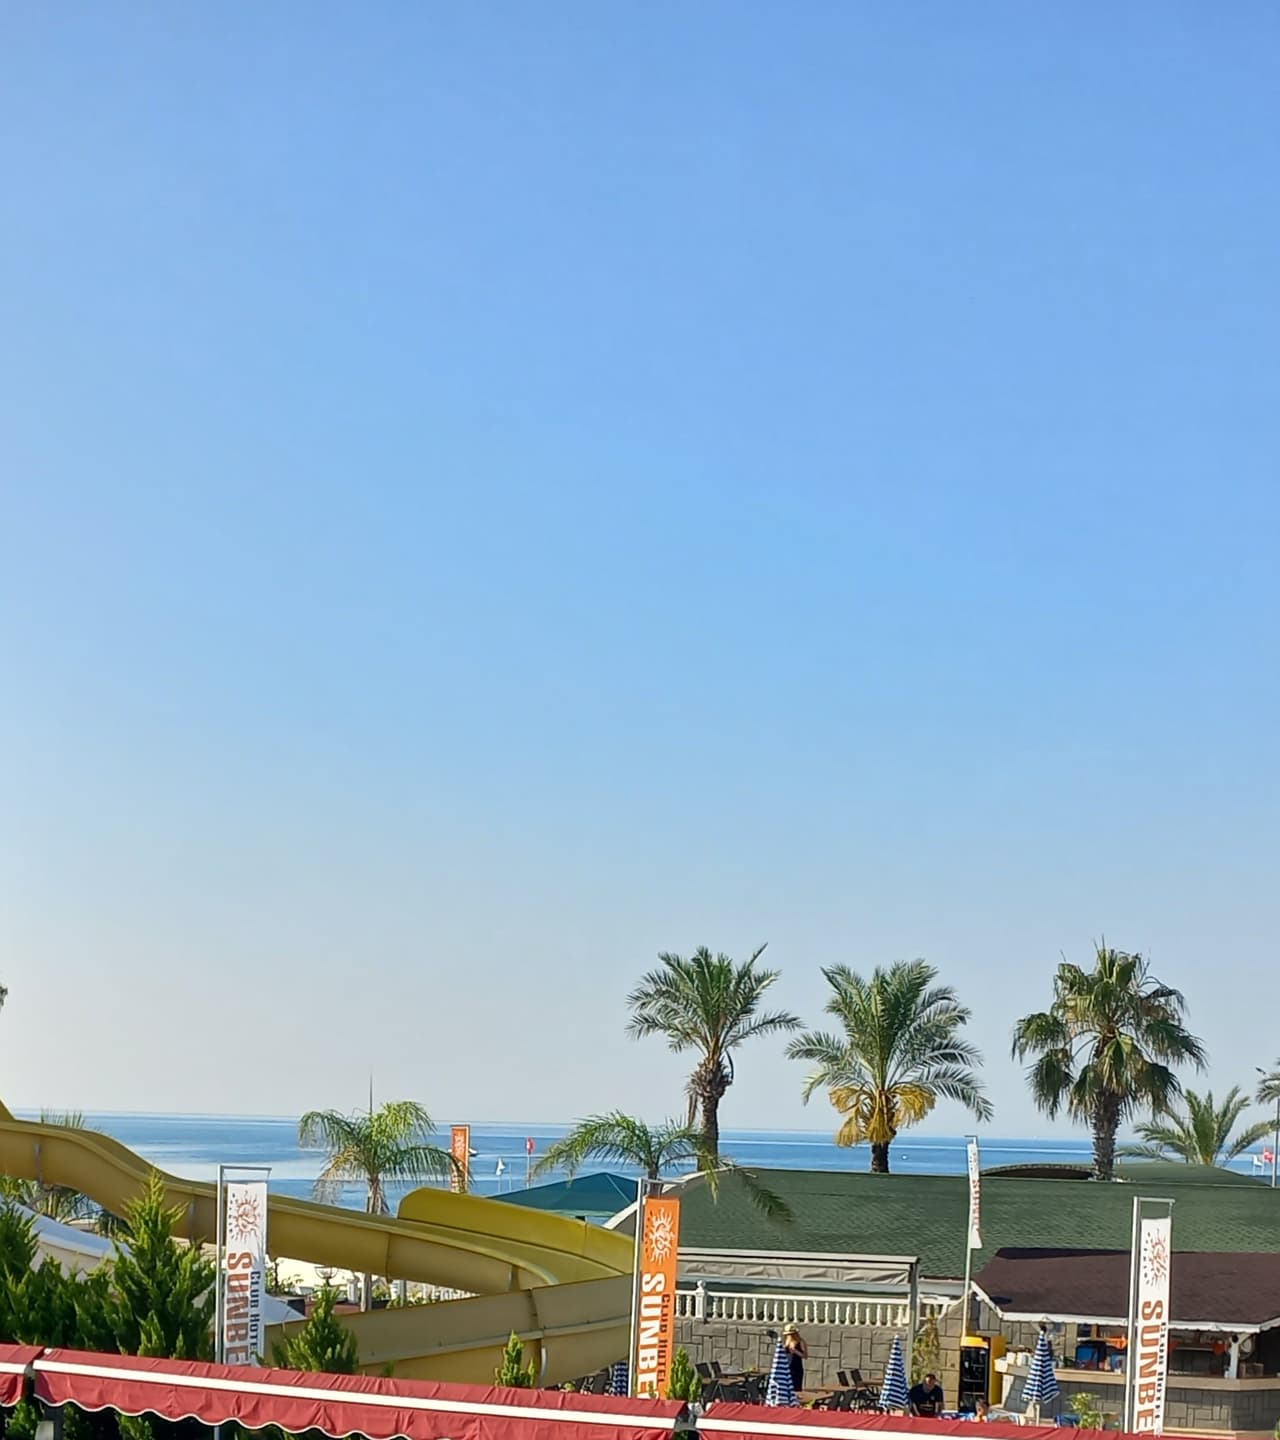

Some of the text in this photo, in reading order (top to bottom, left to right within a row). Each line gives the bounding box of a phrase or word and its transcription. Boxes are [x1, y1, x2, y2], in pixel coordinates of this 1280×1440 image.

[226, 1252, 253, 1366] SUNBE
[250, 1271, 261, 1308] CLUB
[657, 1294, 671, 1385] CLUB HOTEL
[1136, 1300, 1163, 1434] SUNBE
